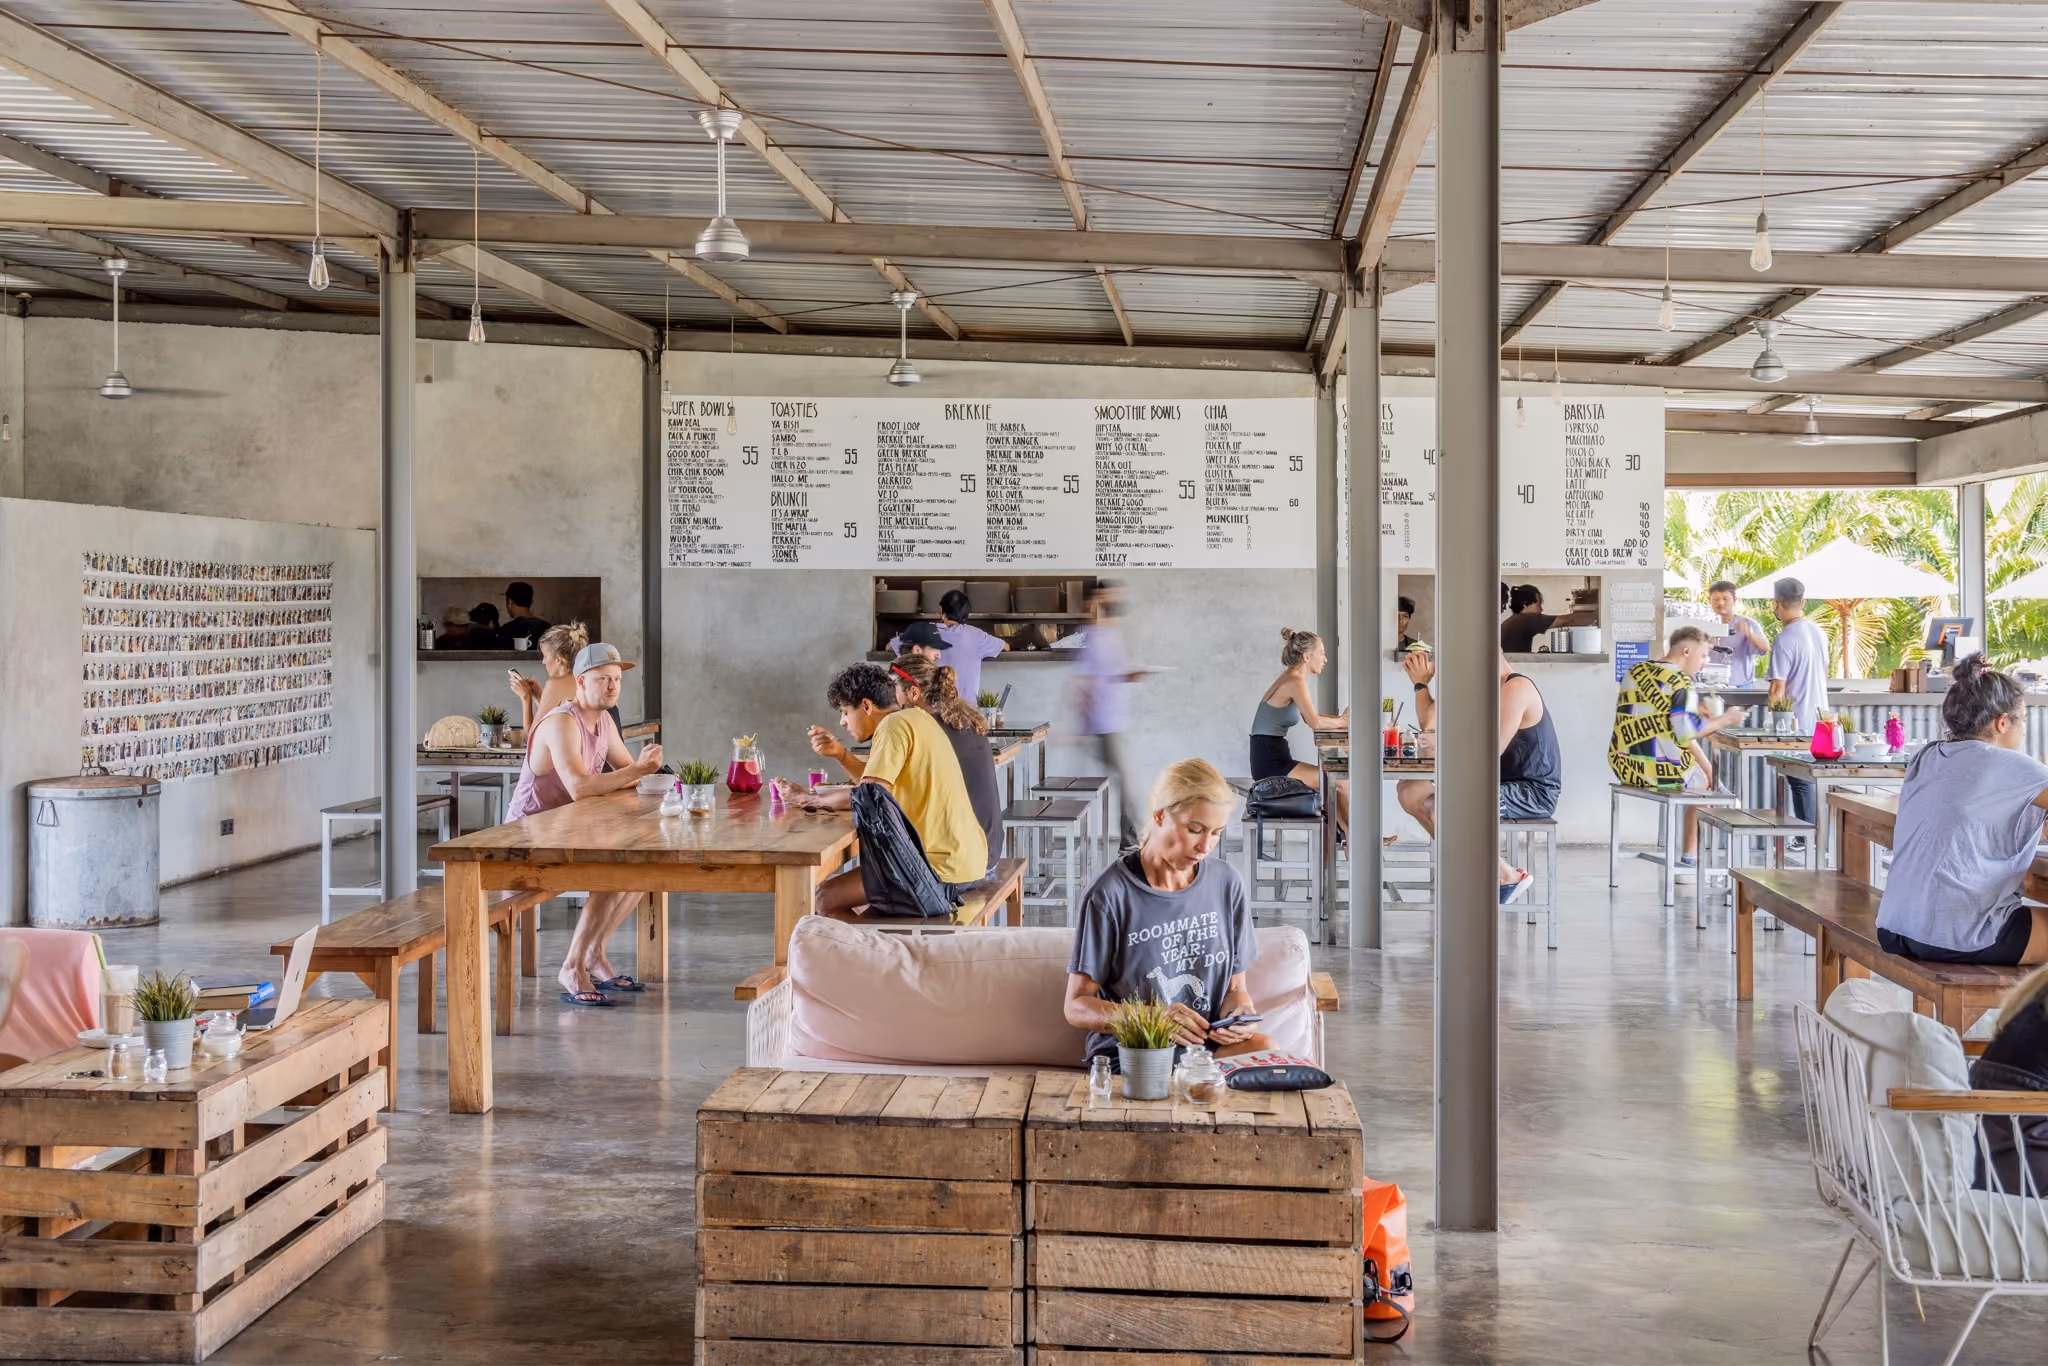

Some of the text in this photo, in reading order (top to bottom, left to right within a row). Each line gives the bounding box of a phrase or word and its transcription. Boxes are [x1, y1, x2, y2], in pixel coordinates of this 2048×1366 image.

[701, 401, 731, 417] BOWLS
[770, 402, 818, 418] TOASTIES
[945, 403, 992, 421] BREKKIE
[1094, 405, 1181, 421] SMOOTHIE BOWLS
[1204, 404, 1228, 420] CHIA
[1565, 404, 1605, 420] BARISTA
[668, 418, 700, 427] RAW DEAL
[771, 420, 799, 429] YA BISH
[878, 422, 921, 431] FROOT LOOP
[1565, 422, 1599, 433] ESPRESSO
[669, 432, 684, 441] PACK
[686, 432, 691, 441] A
[694, 432, 716, 441] PUNCH
[771, 434, 797, 443] SAMBO
[878, 435, 925, 445] BREKKIE PLATE
[986, 437, 1039, 446] POWER RANGER
[1565, 435, 1605, 446] MACCHIATO
[1095, 442, 1112, 451] WHY
[1115, 442, 1123, 451] SO
[667, 450, 710, 458] GOOD ROOT
[743, 446, 758, 465] 55
[845, 448, 858, 465] 55
[878, 449, 928, 458] GREEN BREKKIE
[986, 450, 1044, 460] BREKKIE IN BREAD
[1095, 461, 1132, 470] BLACK OUT
[1229, 456, 1240, 465] ASS
[1289, 455, 1303, 471] 55
[1565, 457, 1611, 468] LONG BLACK
[1625, 454, 1641, 471] 30
[668, 467, 724, 477] CHIK CHIK BOOM
[878, 463, 919, 472] PEAS PLEASE
[986, 464, 1018, 473] MR BEAN
[1204, 470, 1234, 479] CLUSTER
[1565, 468, 1608, 479] FLAT WHITE
[771, 475, 795, 483] HALLO
[960, 474, 976, 492] 55
[1063, 475, 1079, 493] 55
[1565, 479, 1587, 489] LATTE
[1095, 480, 1138, 489] BOWLARAMA
[1179, 480, 1195, 499] 55
[771, 491, 808, 507] BRUNCH
[986, 490, 1024, 499] ROLL OVER
[1392, 491, 1414, 501] SHAKE
[1518, 485, 1535, 504] 40
[1565, 490, 1604, 501] CAPPUCCINO
[986, 503, 1021, 513] SHROOMS
[1289, 498, 1300, 508] 60
[1565, 500, 1591, 510] MOCHA
[1639, 502, 1650, 511] 40
[771, 508, 809, 518] IT'S A WRAP
[1576, 510, 1594, 519] LATTE
[1639, 512, 1650, 520] 40
[670, 517, 717, 525] CURRY MUNCH
[879, 517, 929, 526] THE MELVILLE
[986, 517, 1023, 525] NOM NOM
[1206, 514, 1249, 525] MUNCHIES
[1639, 520, 1650, 529] 40
[771, 522, 807, 531] THE MAFIA
[844, 522, 857, 538] 55
[878, 530, 895, 539] KISS
[1565, 528, 1585, 538] DIRTY
[1639, 529, 1650, 538] 40
[771, 536, 802, 545] PERKKIE
[1624, 538, 1649, 548] ADD 10
[771, 550, 798, 558] STONER
[985, 544, 1015, 554] FRENCHY
[1565, 548, 1633, 558] CRATE COLD BREW
[1639, 549, 1649, 558] 40
[1565, 557, 1590, 567] VGATO
[1637, 558, 1648, 567] 45
[1127, 911, 1218, 947] ROOMMATE
[1162, 925, 1218, 950] OF THE
[1161, 944, 1206, 965] YEAR:
[1175, 951, 1228, 973] MY DO
